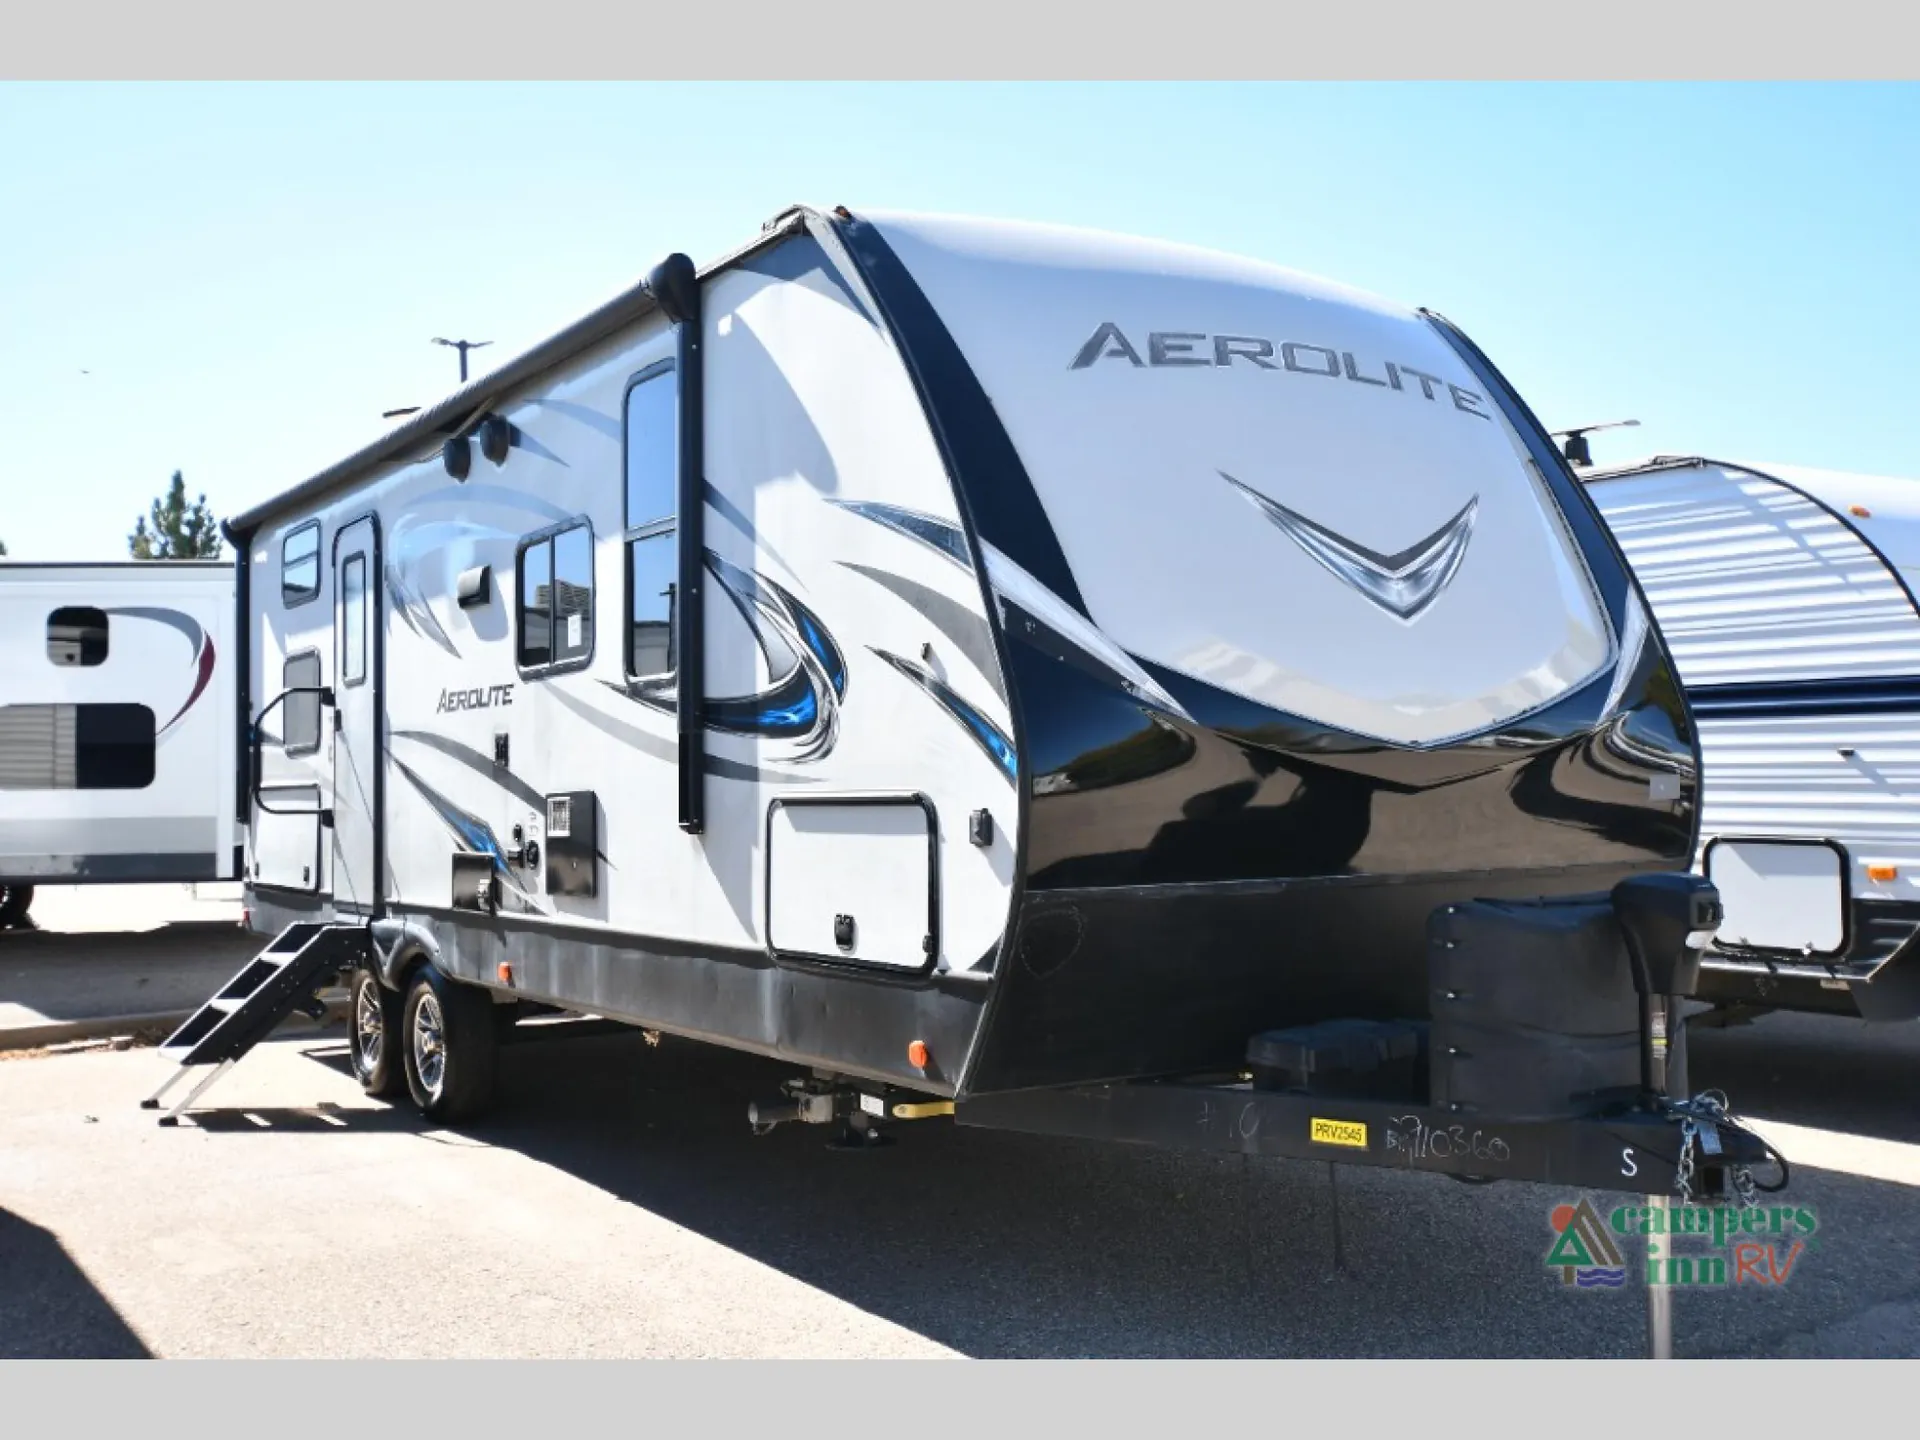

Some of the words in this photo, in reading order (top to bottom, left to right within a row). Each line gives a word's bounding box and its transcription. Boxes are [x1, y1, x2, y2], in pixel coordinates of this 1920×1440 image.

[1068, 321, 1491, 421] AEROLITE
[437, 684, 515, 714] AEROLITE
[1621, 1148, 1638, 1176] S
